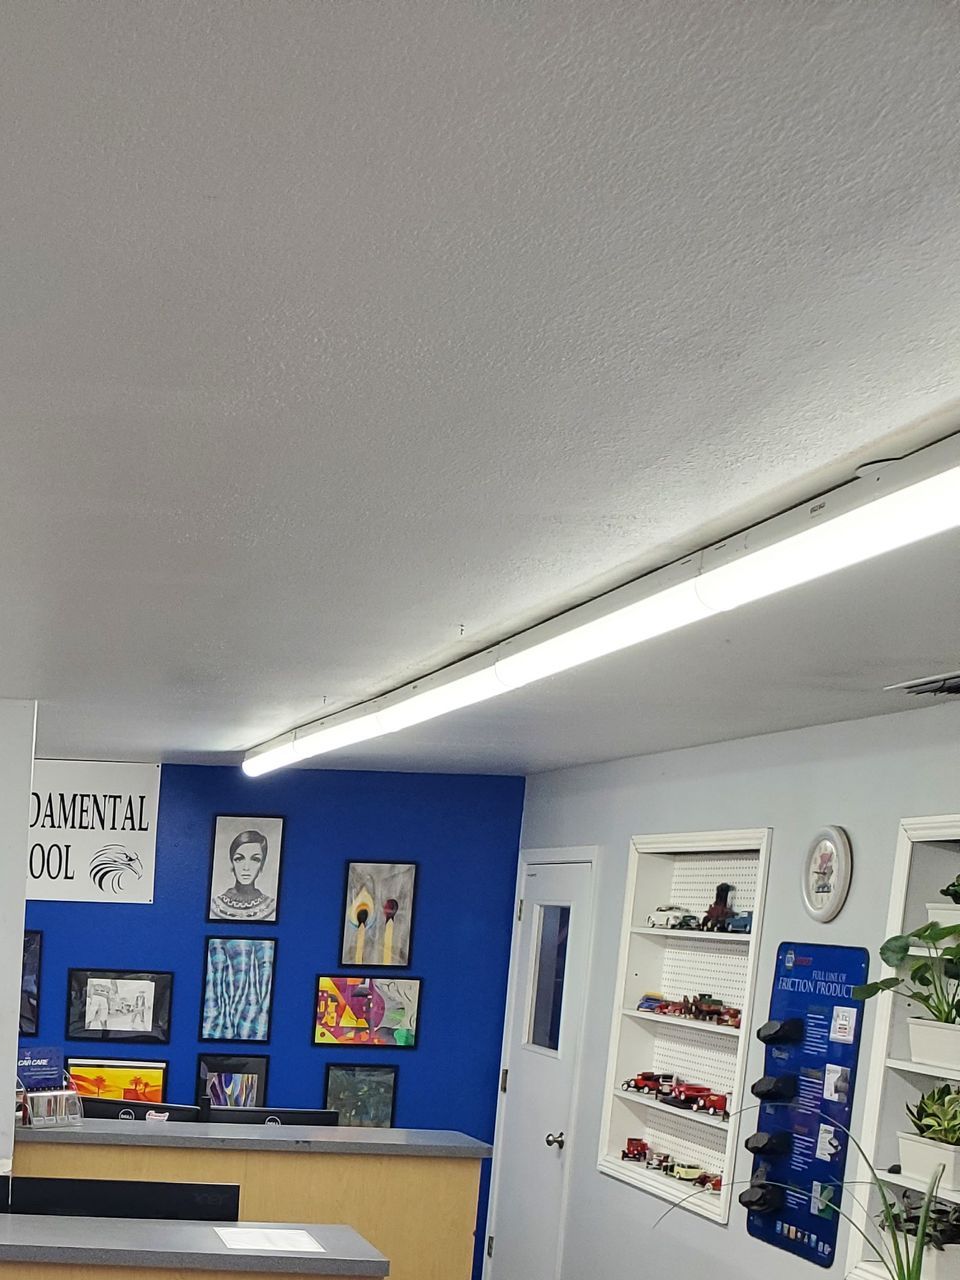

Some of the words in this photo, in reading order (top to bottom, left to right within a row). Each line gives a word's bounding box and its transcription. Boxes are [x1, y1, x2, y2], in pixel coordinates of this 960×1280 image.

[29, 843, 75, 880] OOL
[812, 969, 824, 981] FULL
[778, 976, 815, 993] FRICTION
[816, 981, 854, 999] PRODUCT
